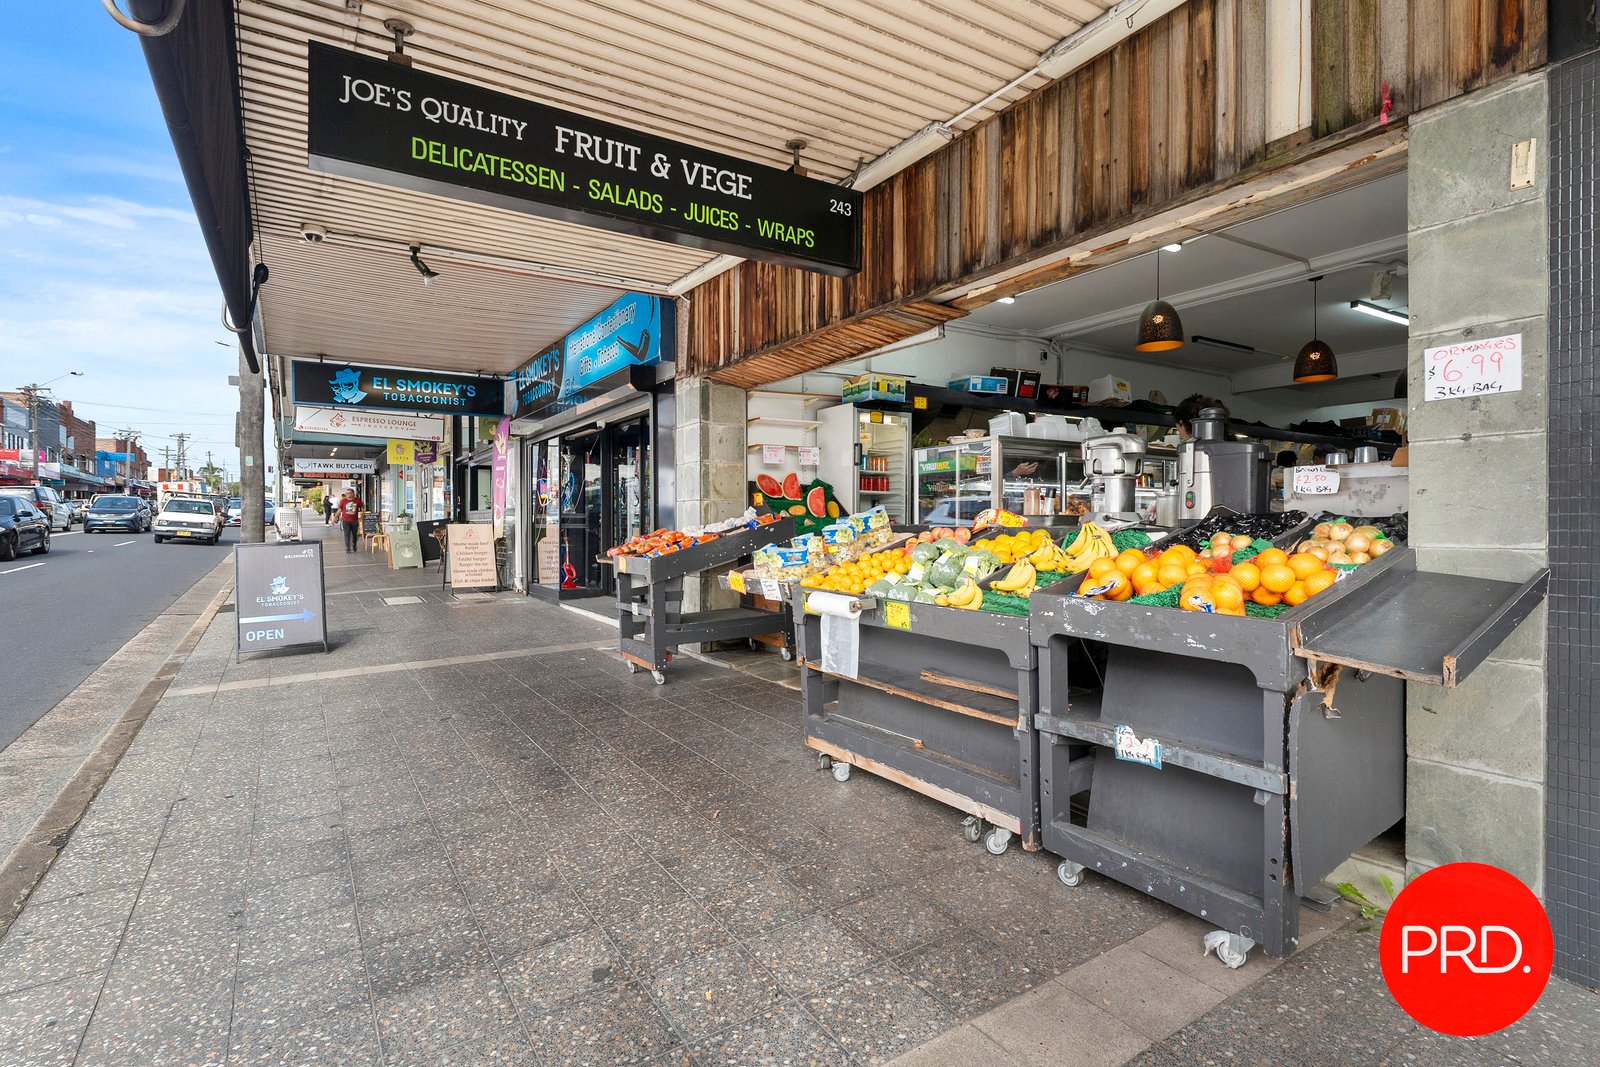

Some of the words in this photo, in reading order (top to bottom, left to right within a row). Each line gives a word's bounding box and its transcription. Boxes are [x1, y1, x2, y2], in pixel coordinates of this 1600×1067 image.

[339, 75, 412, 112] JOE'S
[420, 98, 528, 140] QUALITY
[555, 126, 640, 172] FRUIT
[650, 153, 672, 179] &
[680, 158, 752, 200] VEGE
[412, 136, 564, 192] DELICATESSEN
[588, 180, 662, 214] SALADS
[684, 202, 739, 230] JUICES
[758, 218, 814, 248] WRAPS
[830, 199, 852, 216] 243
[580, 357, 592, 376] Gifts
[598, 342, 618, 368] Tobacco
[518, 372, 526, 391] EL
[526, 349, 560, 384] SMOKEY'S
[372, 377, 392, 390] EL
[396, 379, 476, 396] SMOKEY'S
[523, 377, 554, 406] TOBACCONIST
[1472, 381, 1502, 392] BAG
[384, 392, 466, 406] TOBACCONIST
[352, 416, 386, 424] ESPRESSO
[266, 594, 304, 602] SMOKEY'S
[246, 628, 284, 642] OPEN
